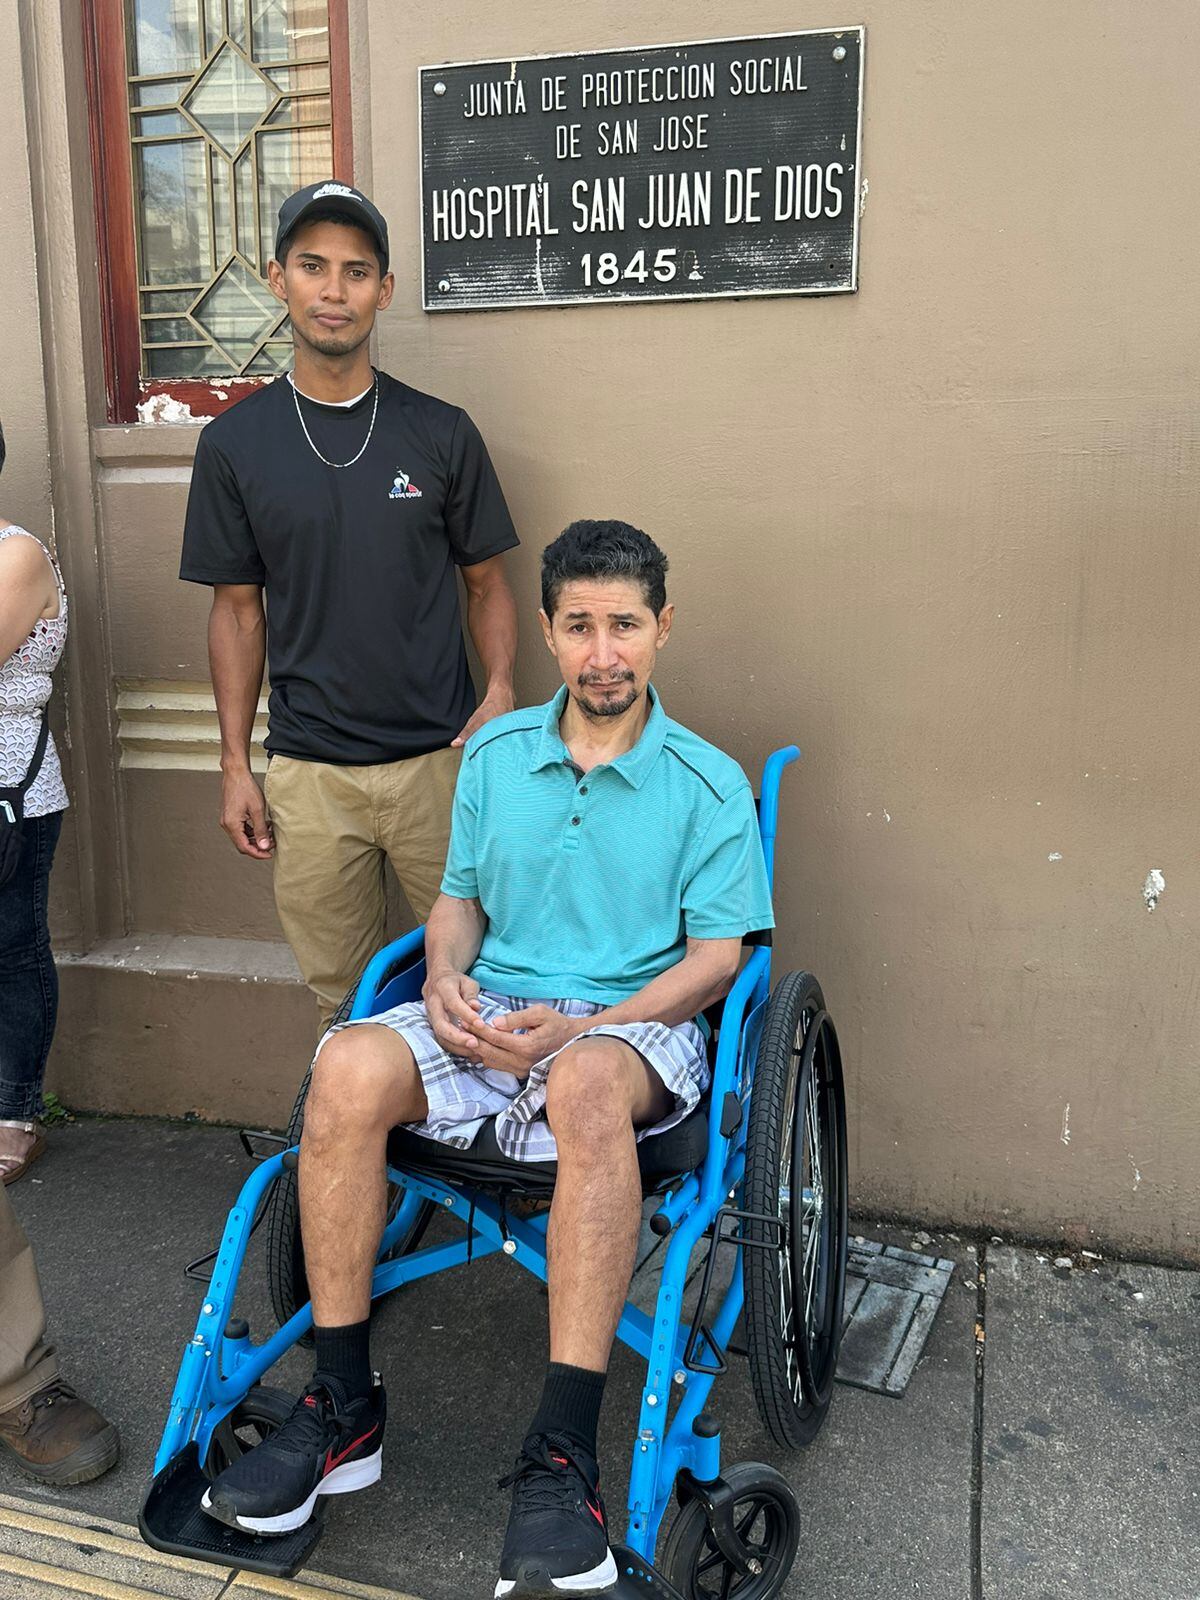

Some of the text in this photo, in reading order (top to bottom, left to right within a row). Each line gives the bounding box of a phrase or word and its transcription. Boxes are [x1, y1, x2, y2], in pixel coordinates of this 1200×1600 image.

[464, 55, 808, 118] JUNTA DE PROTECCION SOCIAL
[556, 114, 709, 160] DE SAN JOSE
[320, 184, 352, 194] NIKE
[432, 162, 843, 242] HOSPITAL SAN JUAN DE DIOS
[581, 248, 677, 287] 1845
